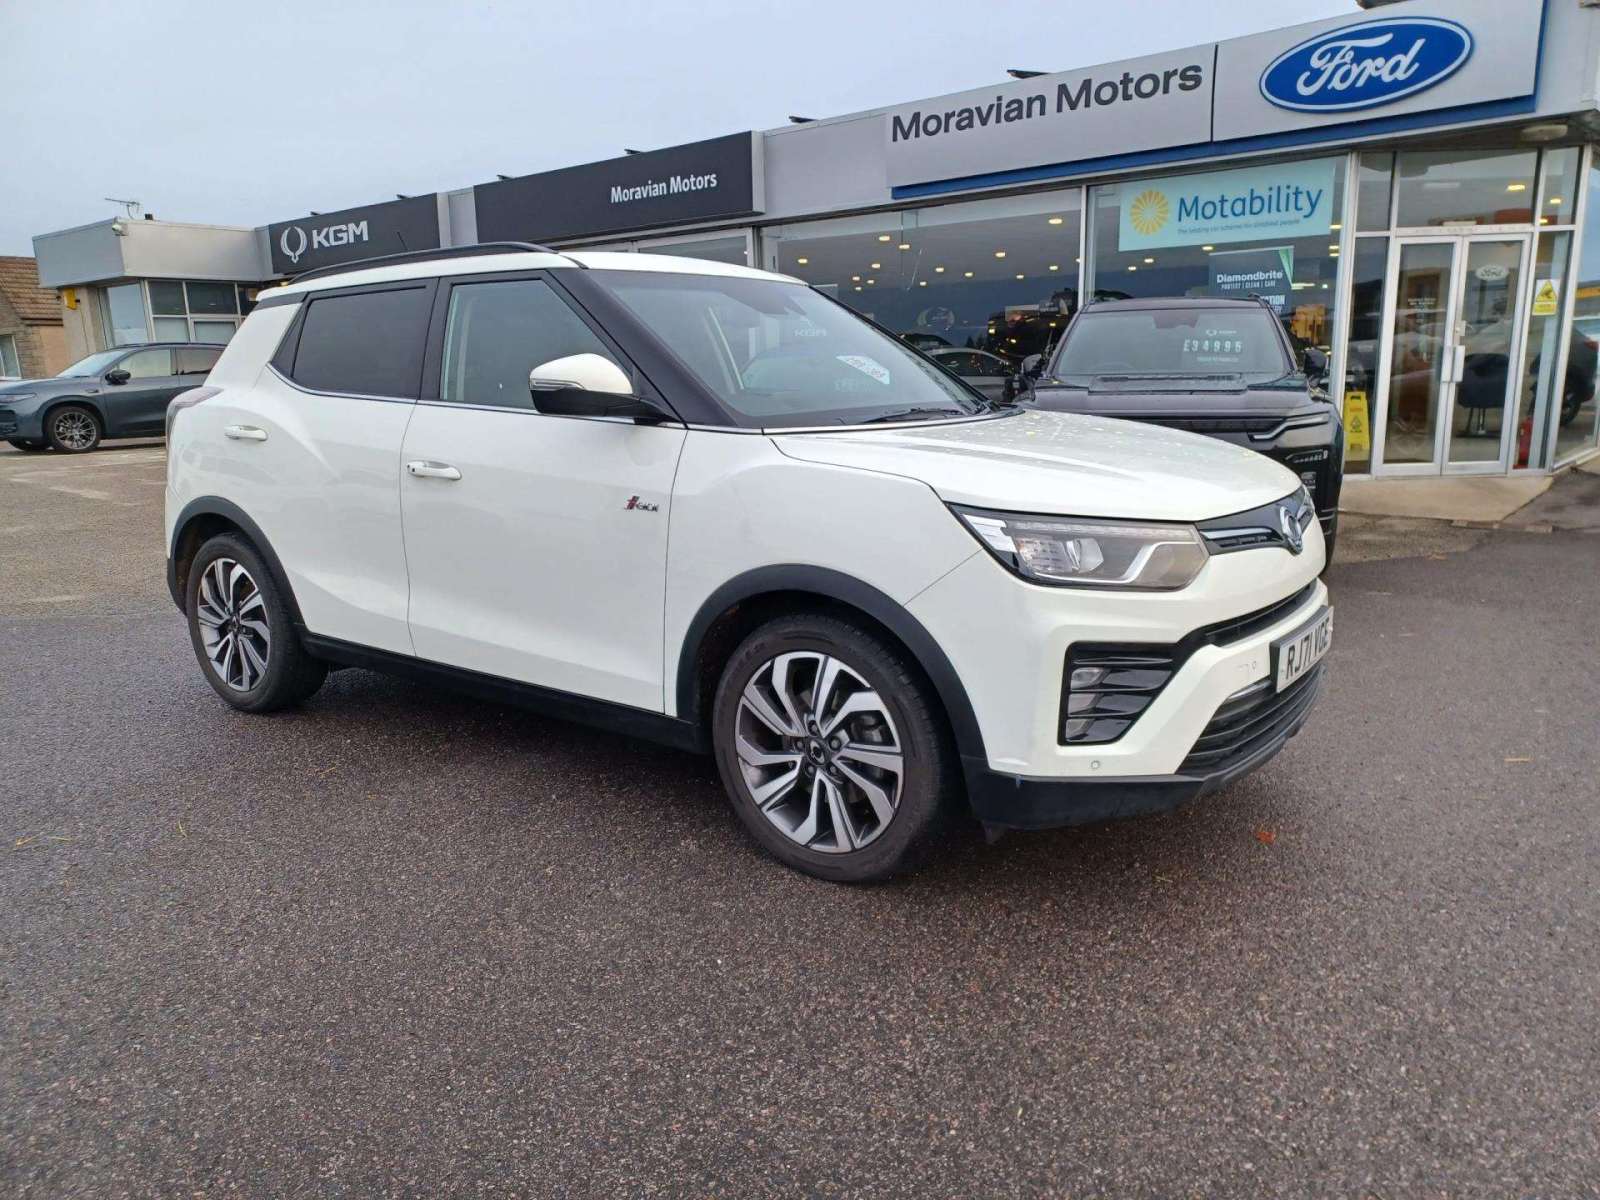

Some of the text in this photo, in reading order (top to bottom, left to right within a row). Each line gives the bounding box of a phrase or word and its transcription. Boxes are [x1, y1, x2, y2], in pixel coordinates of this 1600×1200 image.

[1296, 33, 1426, 96] Ford
[892, 65, 1203, 142] Moravian Motors
[610, 174, 718, 203] Moravian Motors
[1177, 185, 1323, 222] Motability
[312, 220, 369, 249] KGM
[1216, 270, 1283, 283] Diamondbrite
[1285, 631, 1314, 680] RJ71
